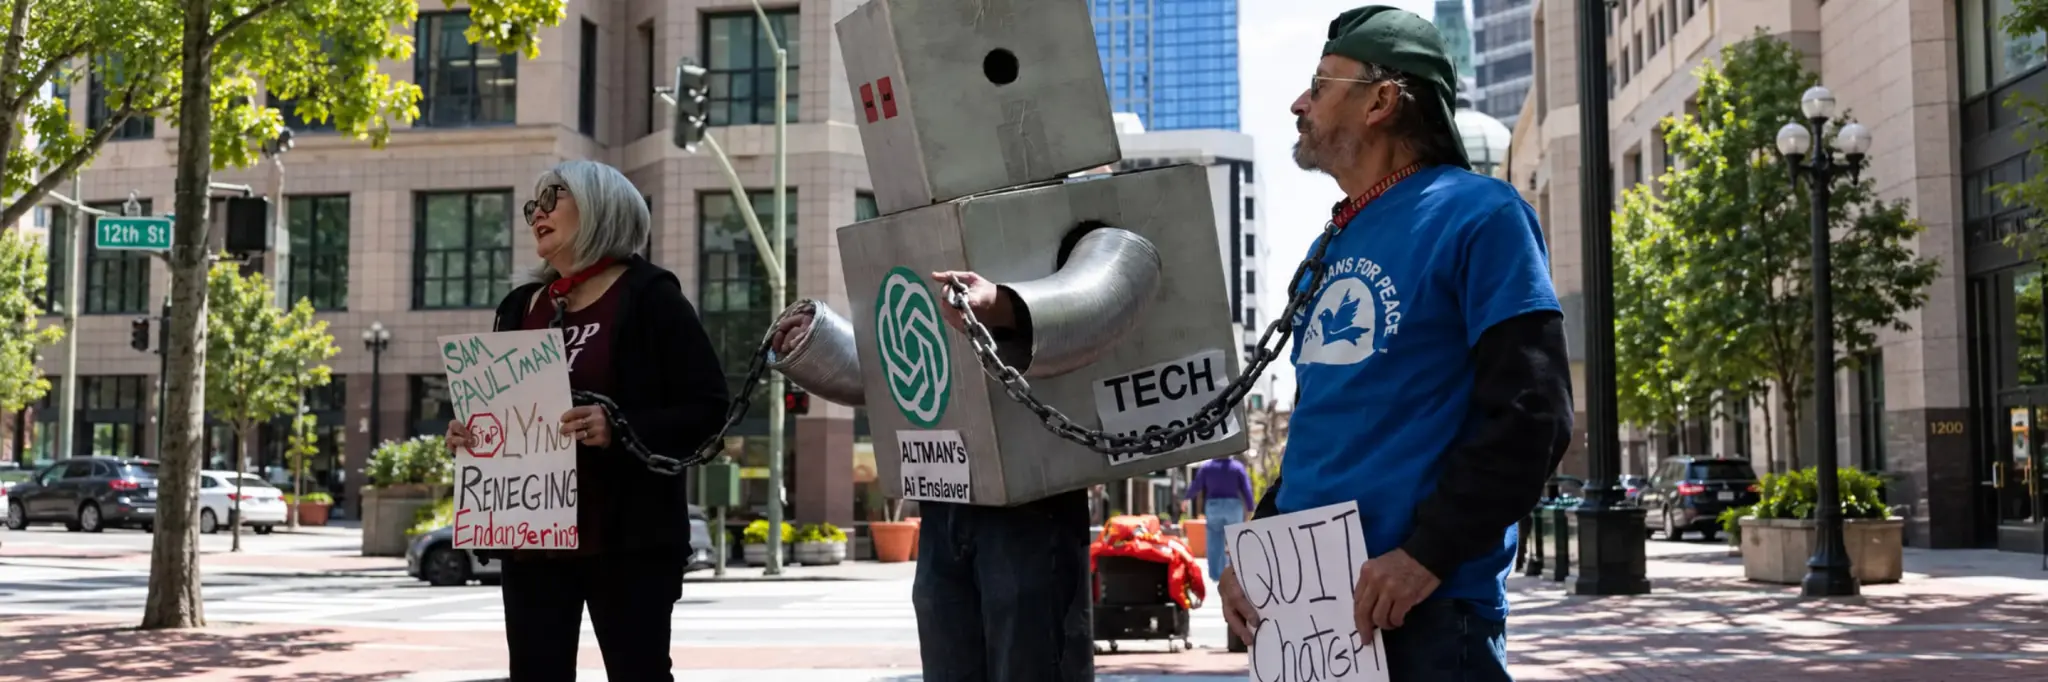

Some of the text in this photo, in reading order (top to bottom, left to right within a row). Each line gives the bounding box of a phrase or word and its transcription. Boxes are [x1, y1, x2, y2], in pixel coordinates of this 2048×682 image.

[104, 223, 165, 244] 12th St
[1354, 257, 1381, 282] FOR
[1374, 275, 1402, 337] PEACE
[443, 335, 494, 374] SAM
[1103, 357, 1215, 413] TECH
[1931, 421, 1963, 434] 1200
[902, 440, 967, 464] ALTMAN's
[459, 465, 578, 512] RENEGING
[904, 475, 969, 499] Ai Enslaver
[454, 508, 579, 550] Endangering
[1236, 508, 1357, 610] QUIT
